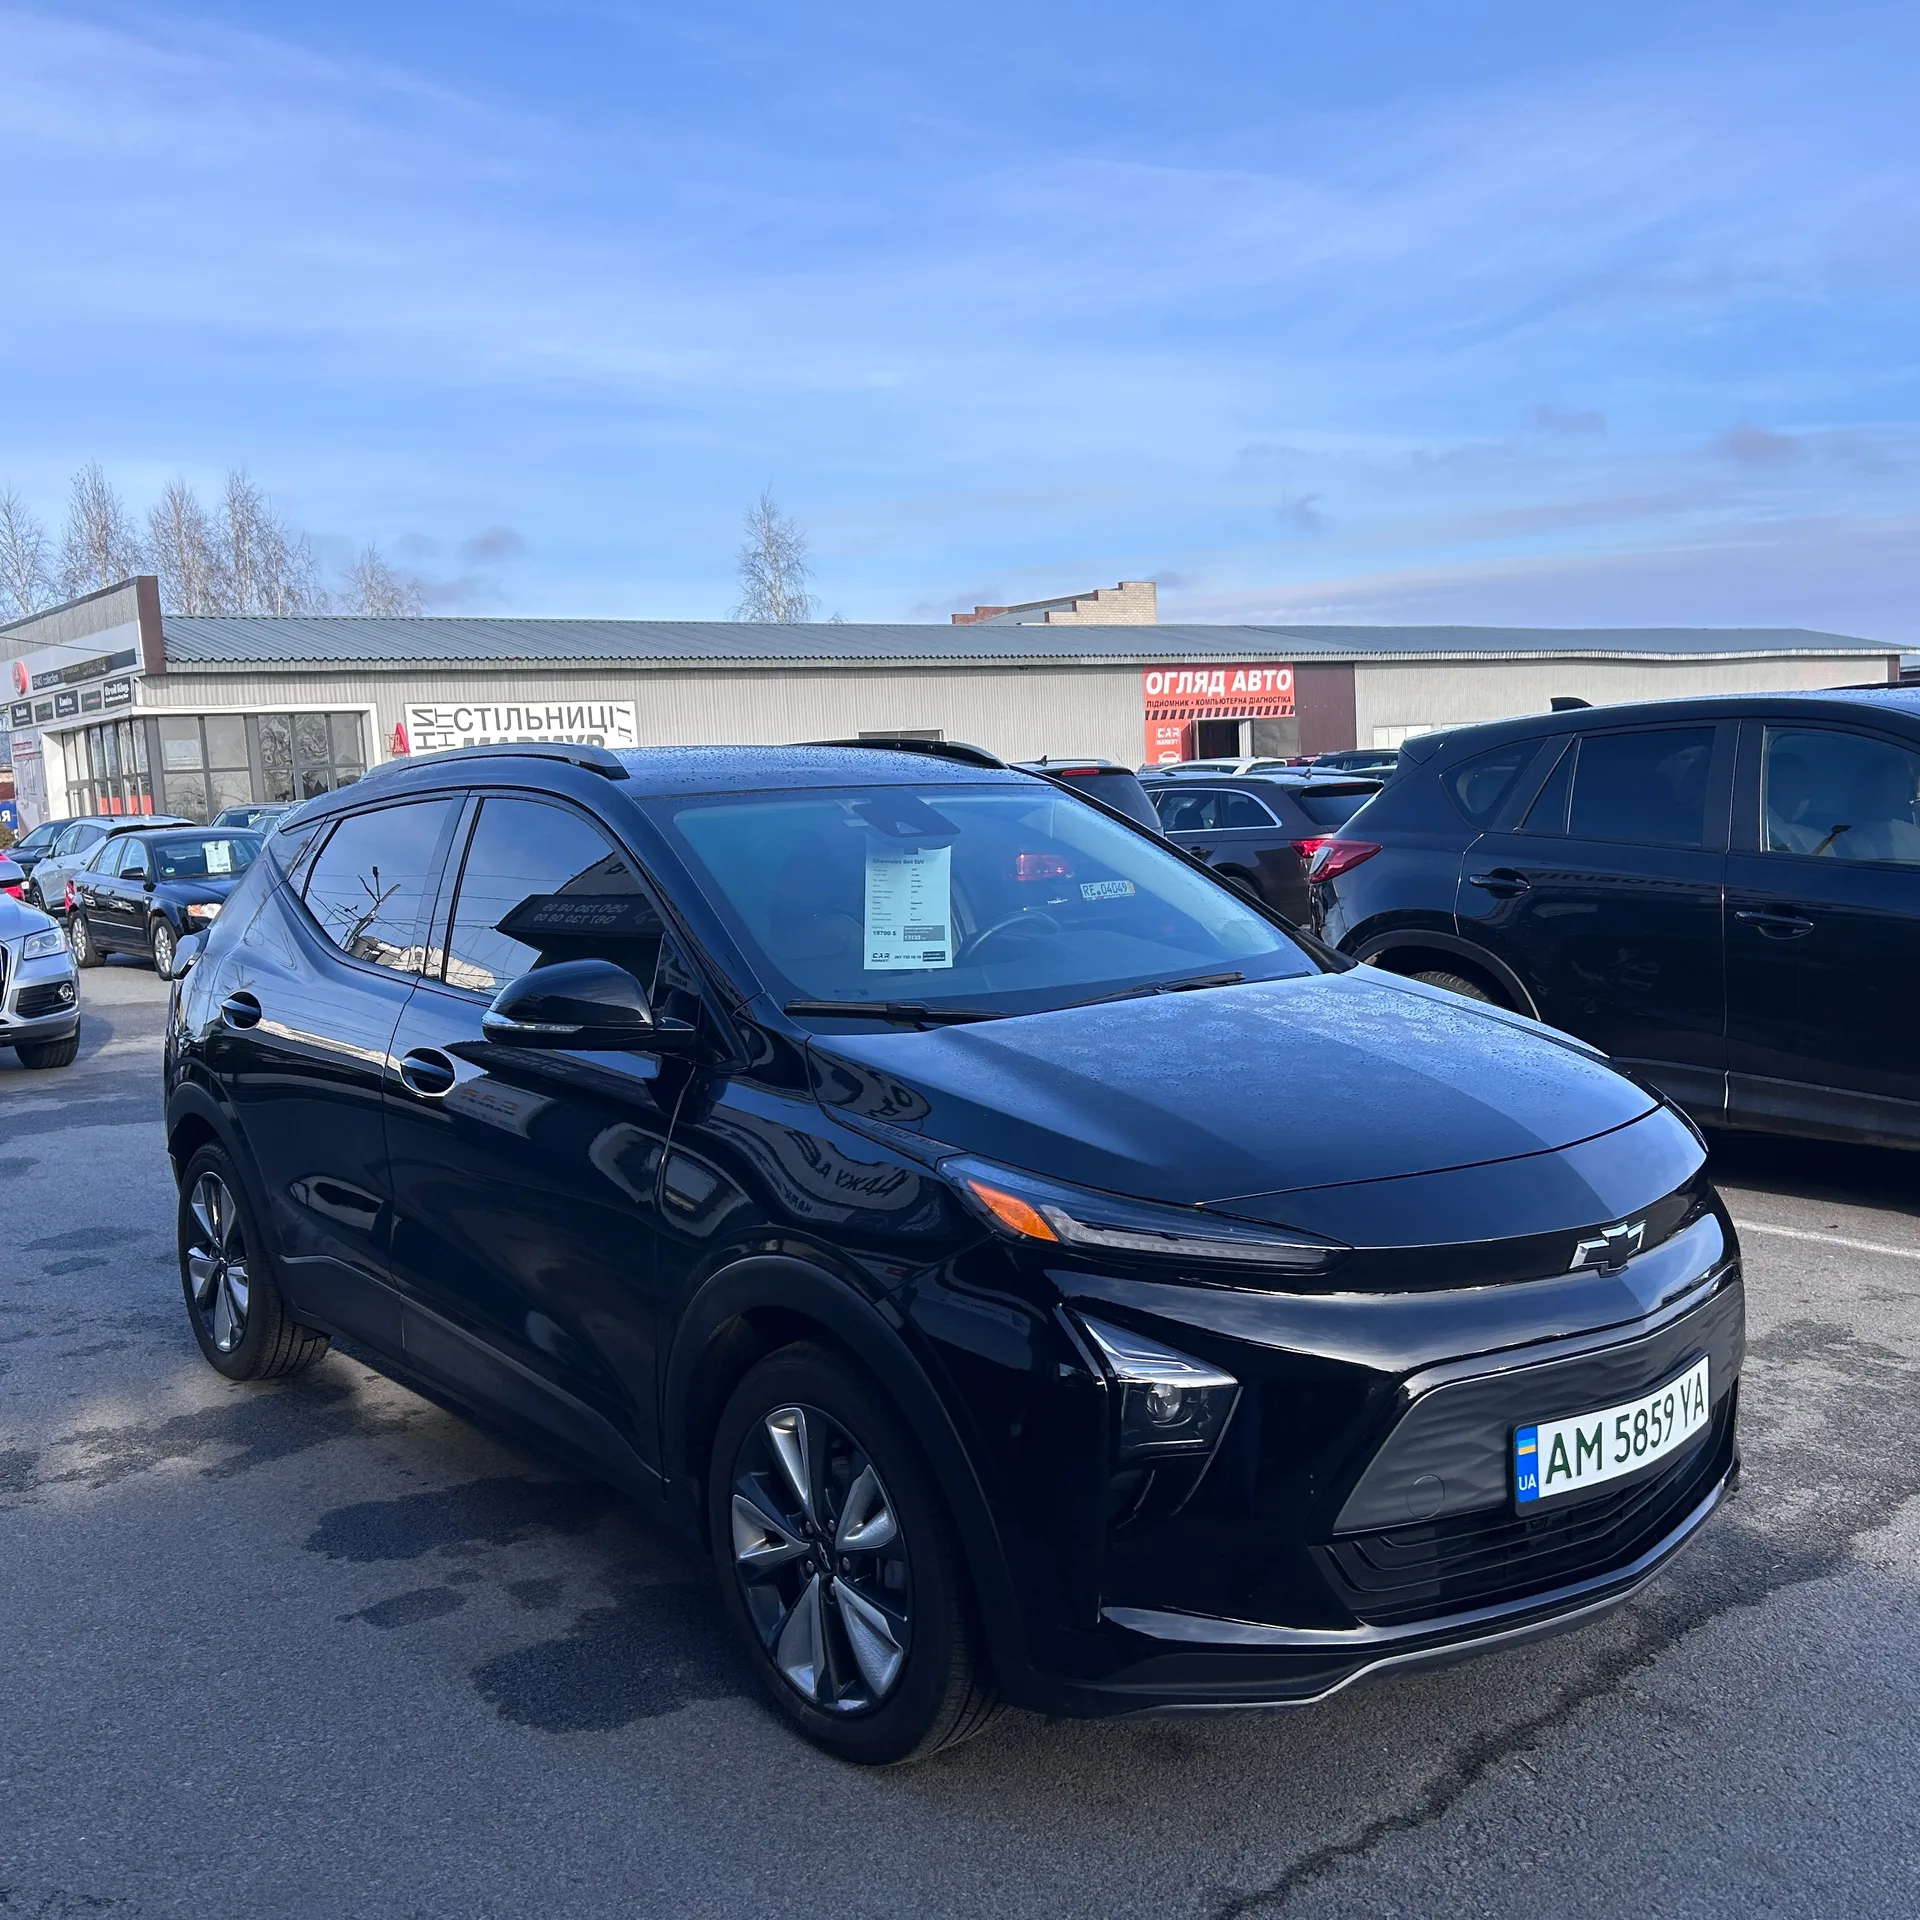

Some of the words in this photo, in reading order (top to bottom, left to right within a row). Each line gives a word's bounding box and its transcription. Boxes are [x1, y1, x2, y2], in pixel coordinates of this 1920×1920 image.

[1146, 670, 1225, 697] ОГЛЯД
[1231, 669, 1292, 692] АВТО
[453, 705, 614, 734] СТІЛЬНИЦІ
[1157, 727, 1180, 738] CAR
[1545, 1421, 1603, 1485] AM
[1614, 1393, 1674, 1463] 5859
[1680, 1372, 1704, 1428] YA
[1518, 1473, 1537, 1492] UA
